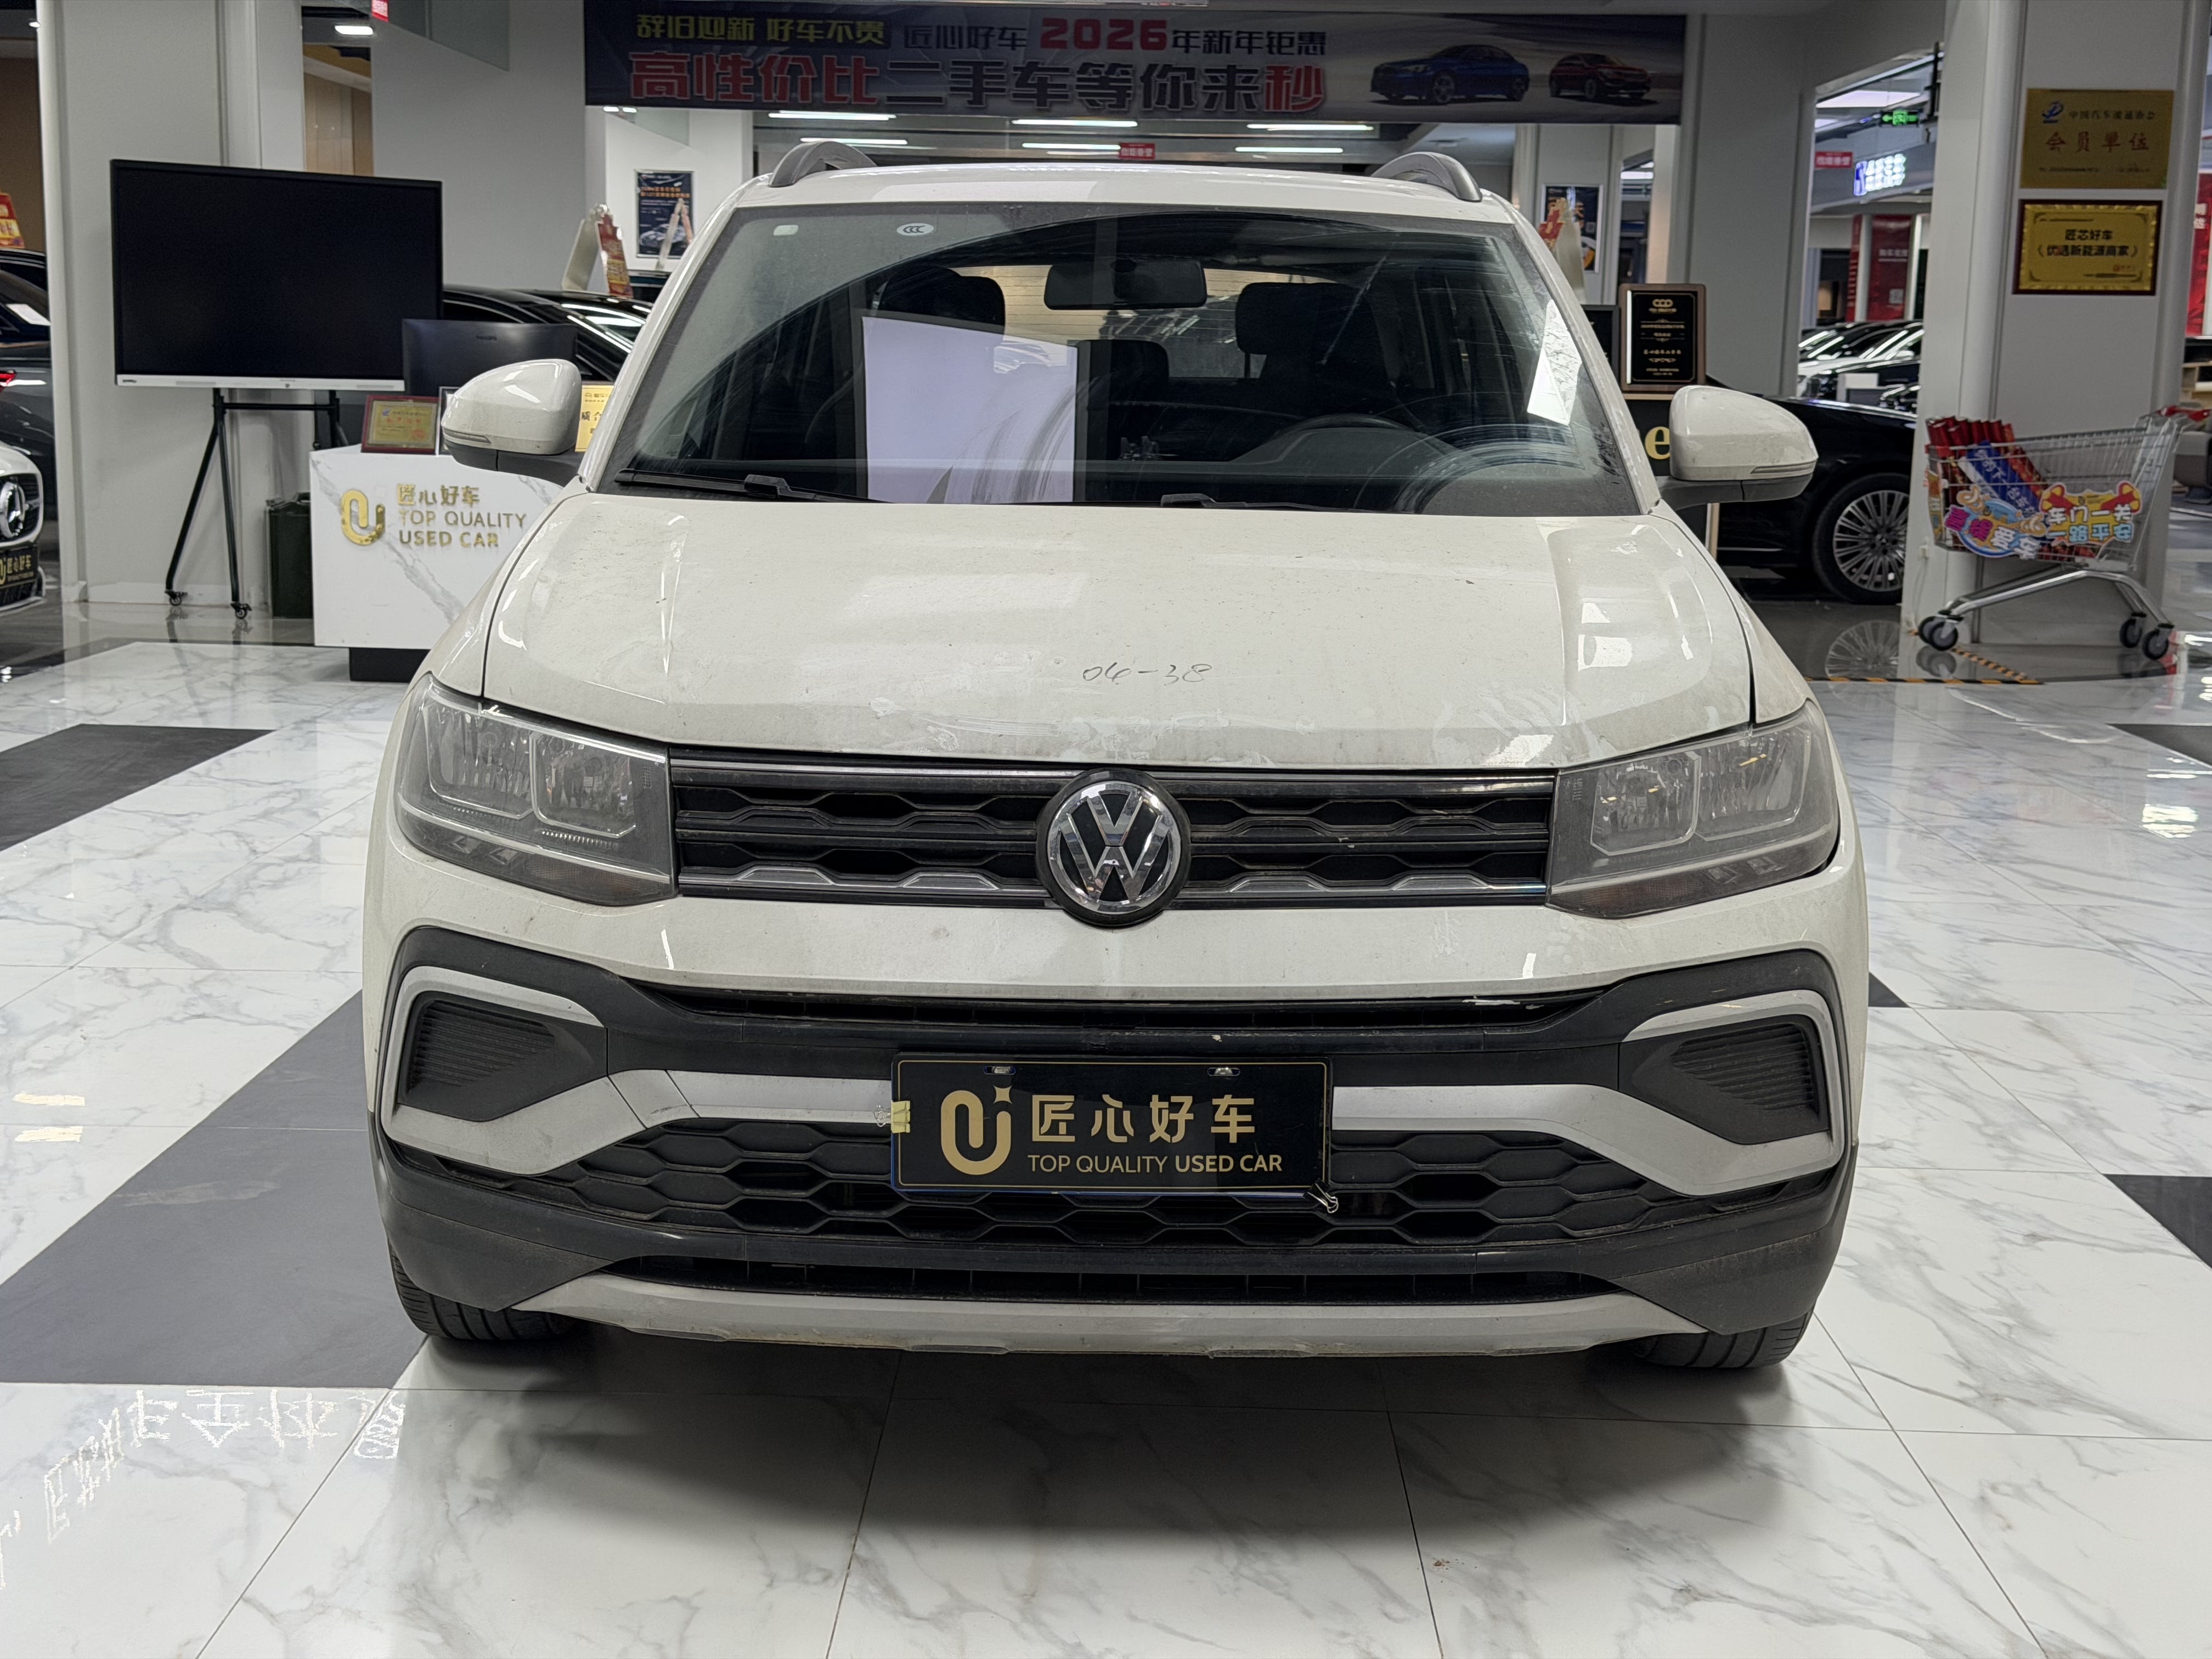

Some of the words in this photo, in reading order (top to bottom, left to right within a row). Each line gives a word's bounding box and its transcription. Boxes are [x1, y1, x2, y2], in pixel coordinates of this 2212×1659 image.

[636, 15, 754, 41] 辞旧迎新
[767, 18, 885, 44] 好车不贵
[904, 26, 1027, 50] 匠心好车
[629, 50, 1325, 112] 高性价比二手车等你来秒
[2045, 131, 2149, 154] 会员单位
[397, 483, 480, 507] 匠心好车
[399, 509, 436, 526] TOP
[444, 511, 527, 529] QUALITY
[2048, 504, 2132, 524] 车门一关
[399, 529, 453, 546] USED
[460, 532, 499, 548] CAR
[2047, 523, 2133, 543] 一路平安
[1032, 1094, 1255, 1143] 匠心好车
[1028, 1155, 1071, 1172] TOP
[1076, 1155, 1167, 1174] QUALITY
[1175, 1155, 1234, 1172] USED
[1240, 1154, 1283, 1172] CAR
